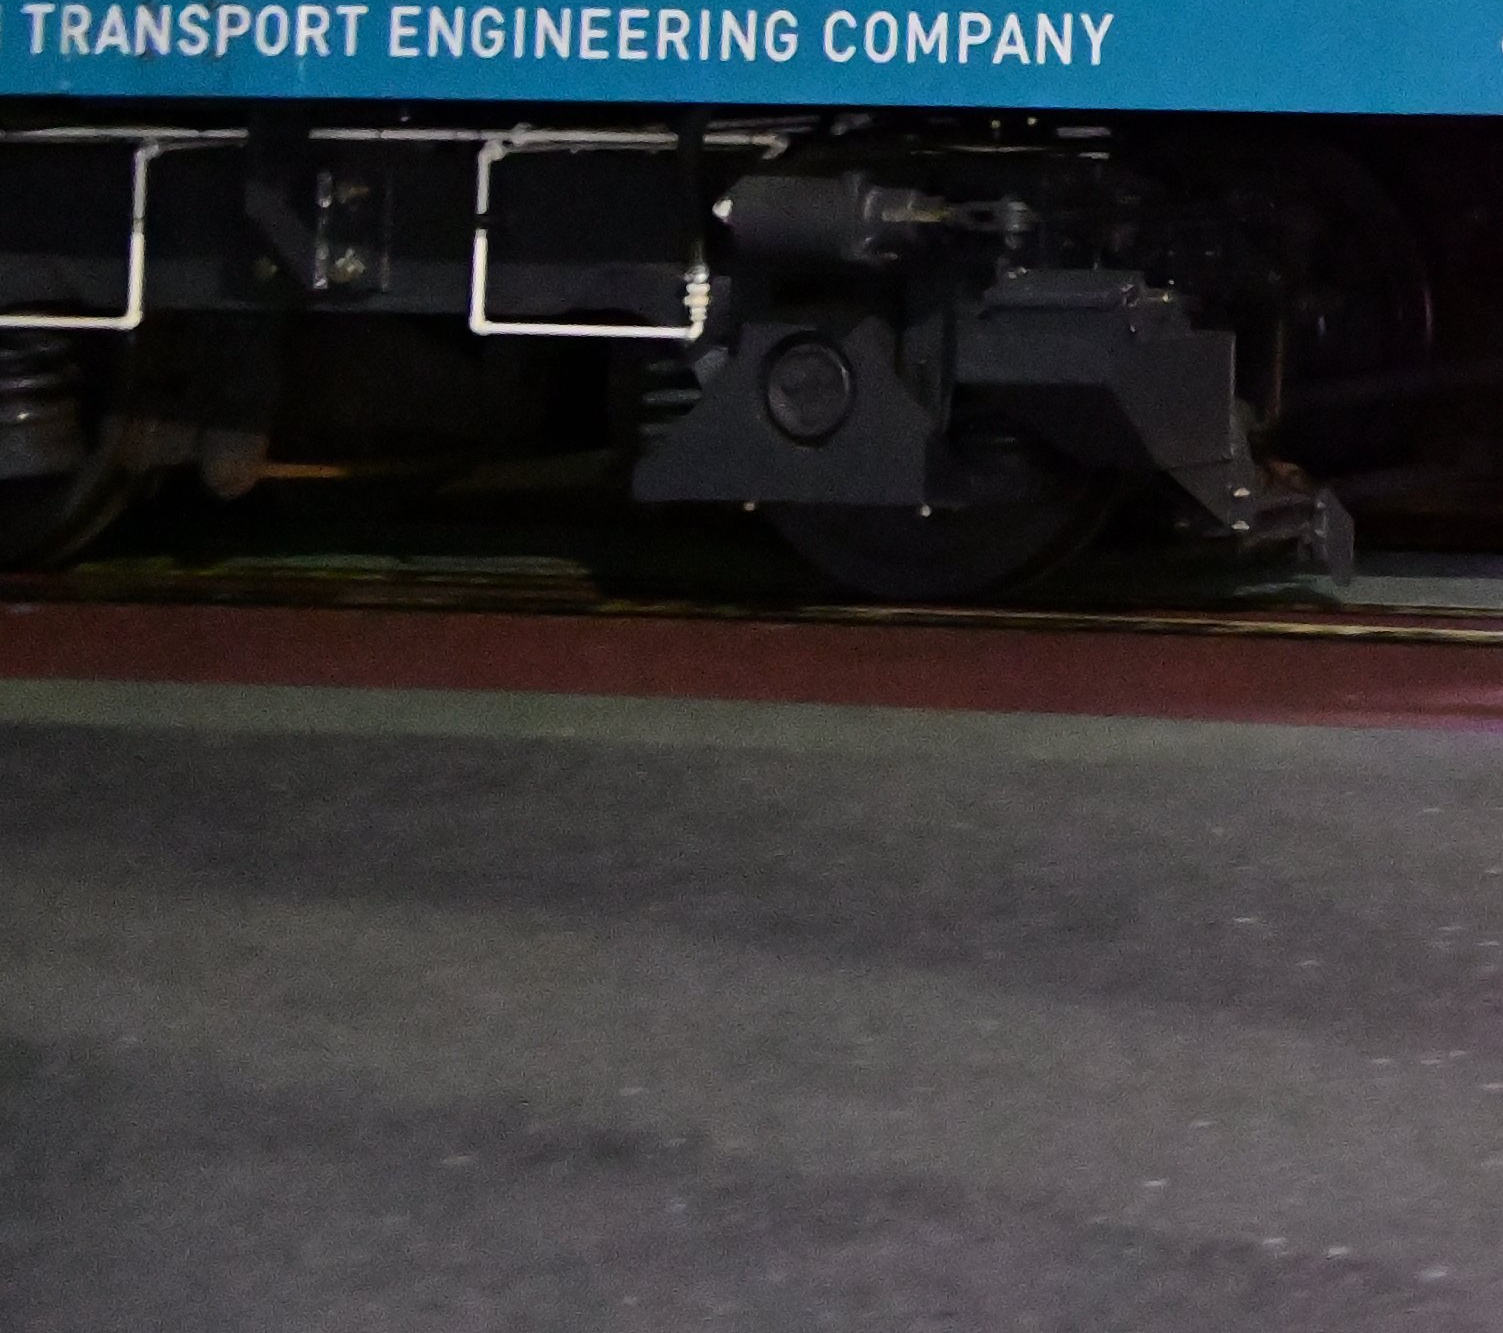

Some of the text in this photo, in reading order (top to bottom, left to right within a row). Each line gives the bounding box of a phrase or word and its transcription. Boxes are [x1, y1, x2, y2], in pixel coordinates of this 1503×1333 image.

[21, 2, 1116, 67] TRANSPORT ENGINEERING COMPANY
